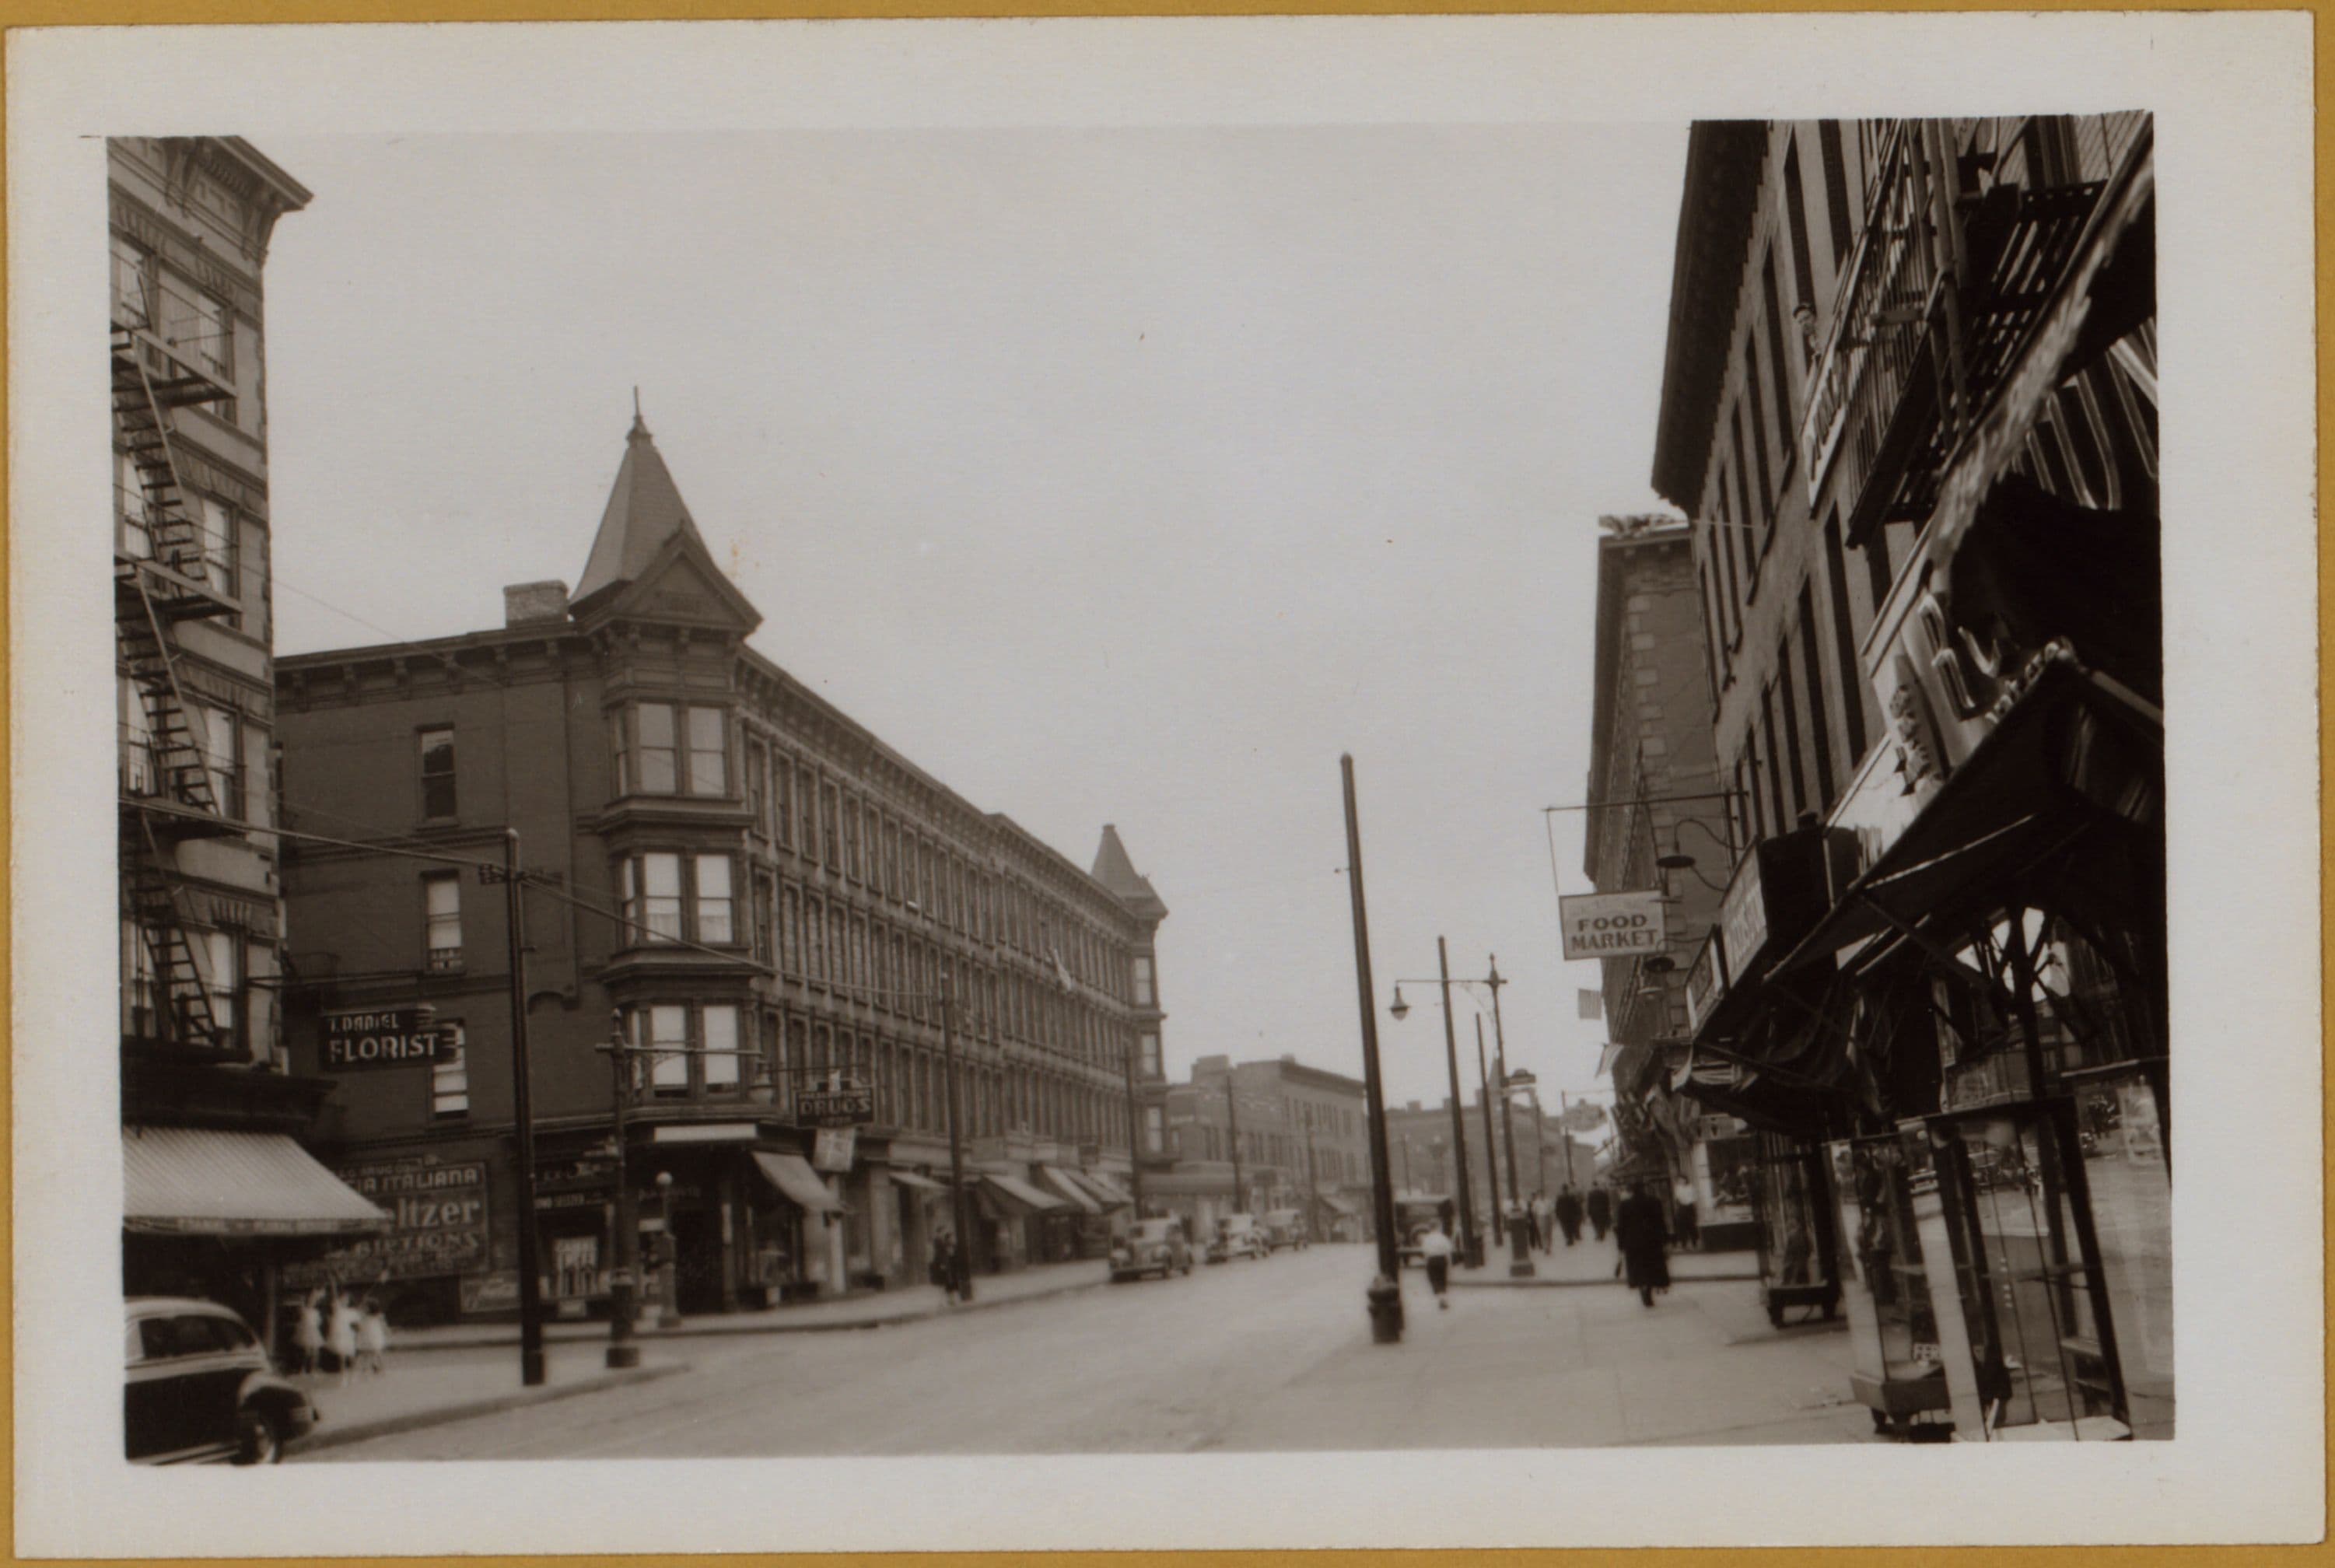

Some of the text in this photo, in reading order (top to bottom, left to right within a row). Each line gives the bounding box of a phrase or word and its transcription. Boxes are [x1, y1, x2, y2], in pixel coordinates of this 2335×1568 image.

[1577, 913, 1647, 933] FOOD
[1570, 929, 1658, 951] MARKET
[328, 1033, 438, 1063] FLORIST
[800, 1097, 872, 1116] DRUGS
[383, 1167, 477, 1192] ITALIANA
[389, 1197, 481, 1228] ltzer
